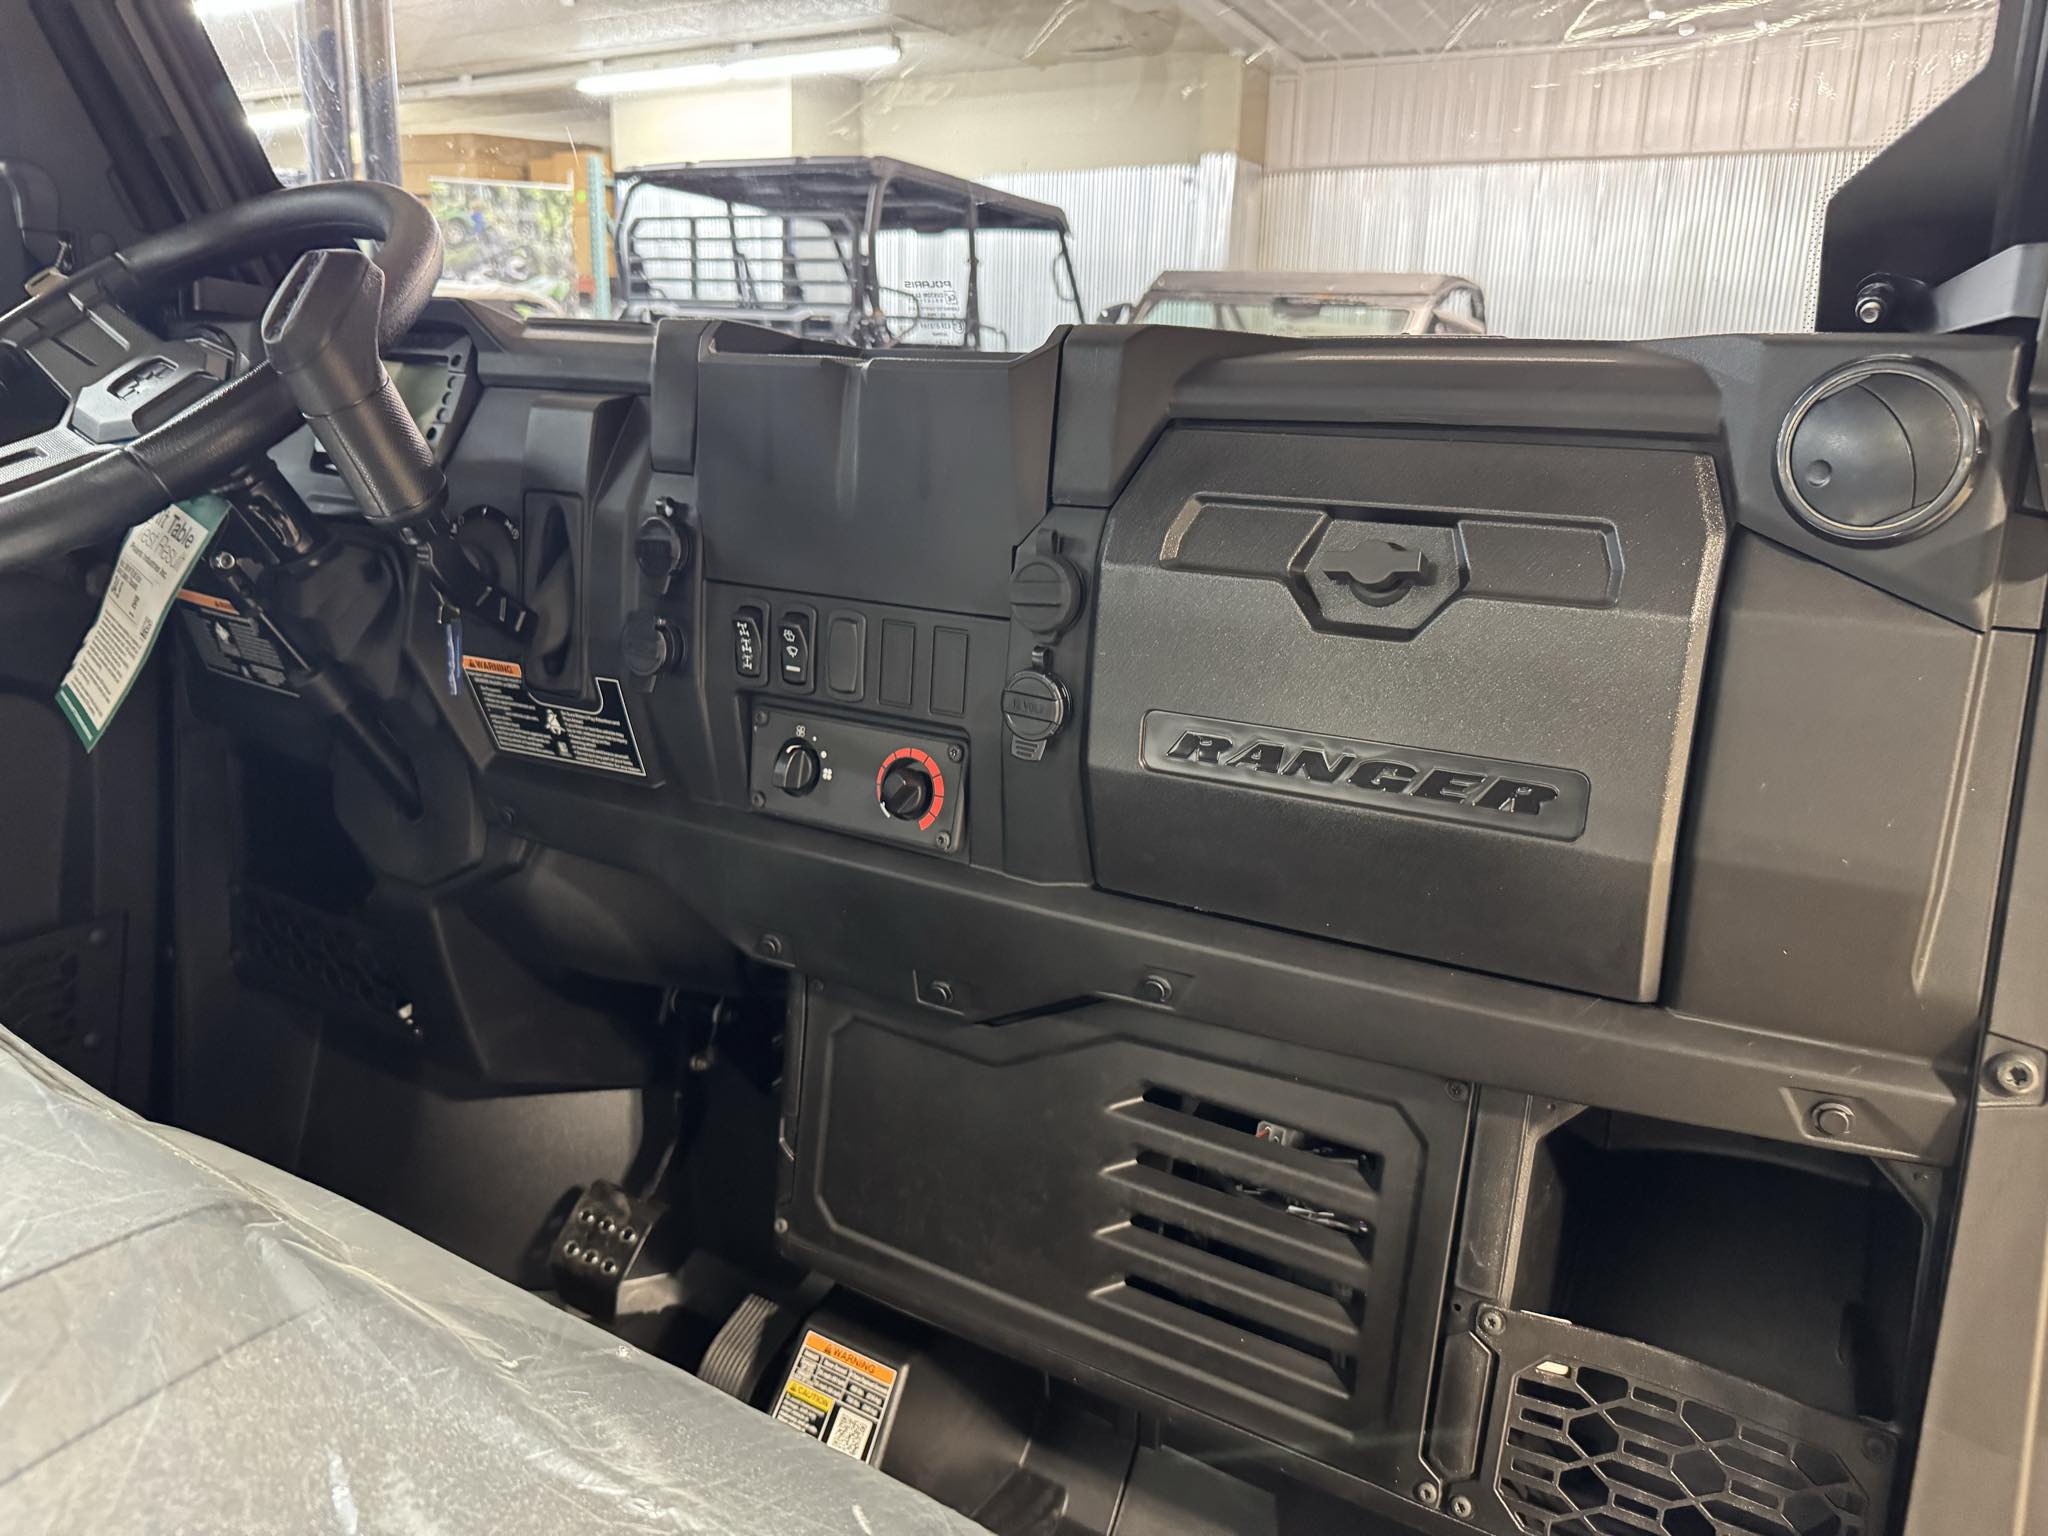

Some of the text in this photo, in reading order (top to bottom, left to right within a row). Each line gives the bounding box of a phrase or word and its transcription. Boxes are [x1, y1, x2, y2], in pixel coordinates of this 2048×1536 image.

[165, 514, 195, 549] Table
[476, 661, 513, 674] WARNING
[1165, 731, 1559, 816] RANGER
[833, 1350, 876, 1374] WARNING
[798, 1387, 830, 1408] CAUTION
